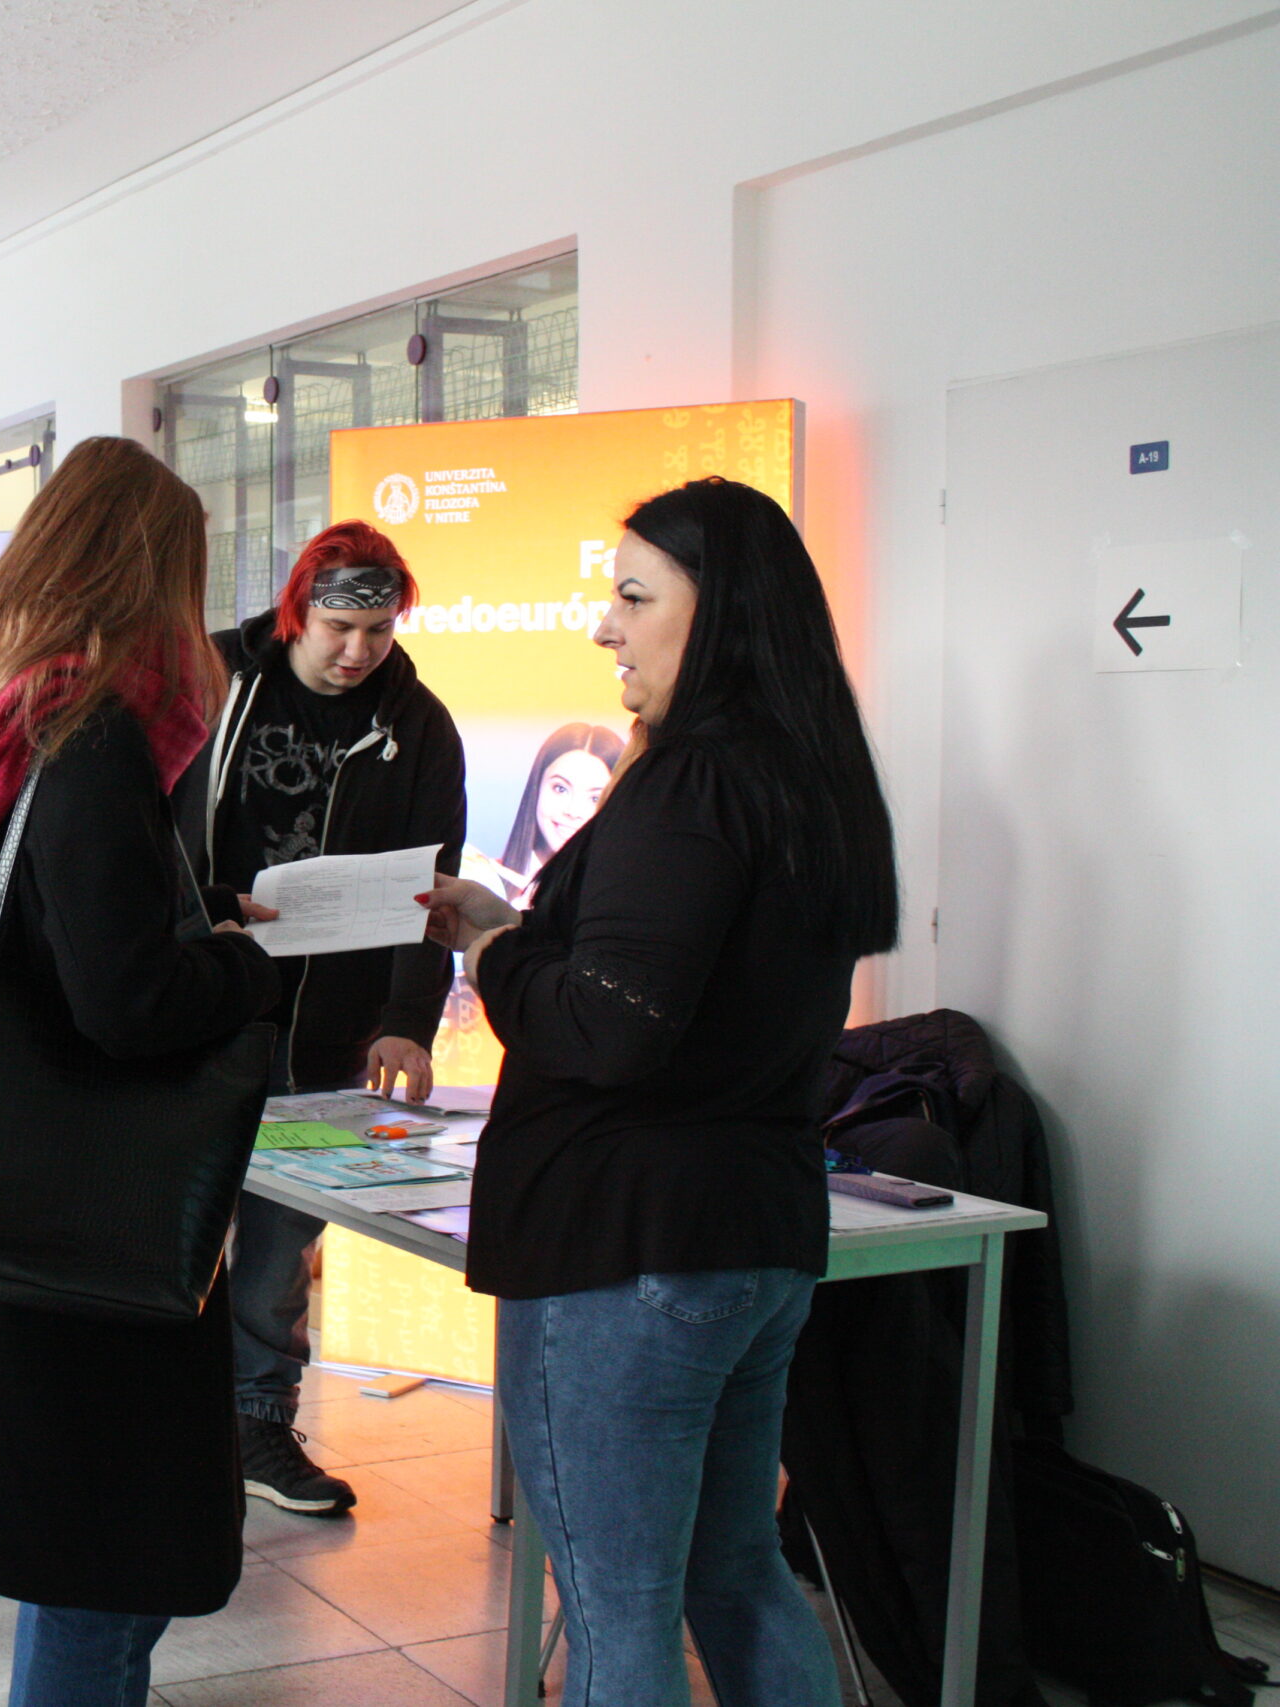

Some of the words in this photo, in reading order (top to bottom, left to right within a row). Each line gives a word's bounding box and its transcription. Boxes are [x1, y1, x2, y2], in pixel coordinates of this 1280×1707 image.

[424, 467, 496, 482] UNIVERZITA
[424, 480, 508, 497] KONŠTANTÍNA
[424, 496, 481, 511] FILOZOFA
[424, 512, 434, 525] V
[435, 511, 472, 524] NITRE
